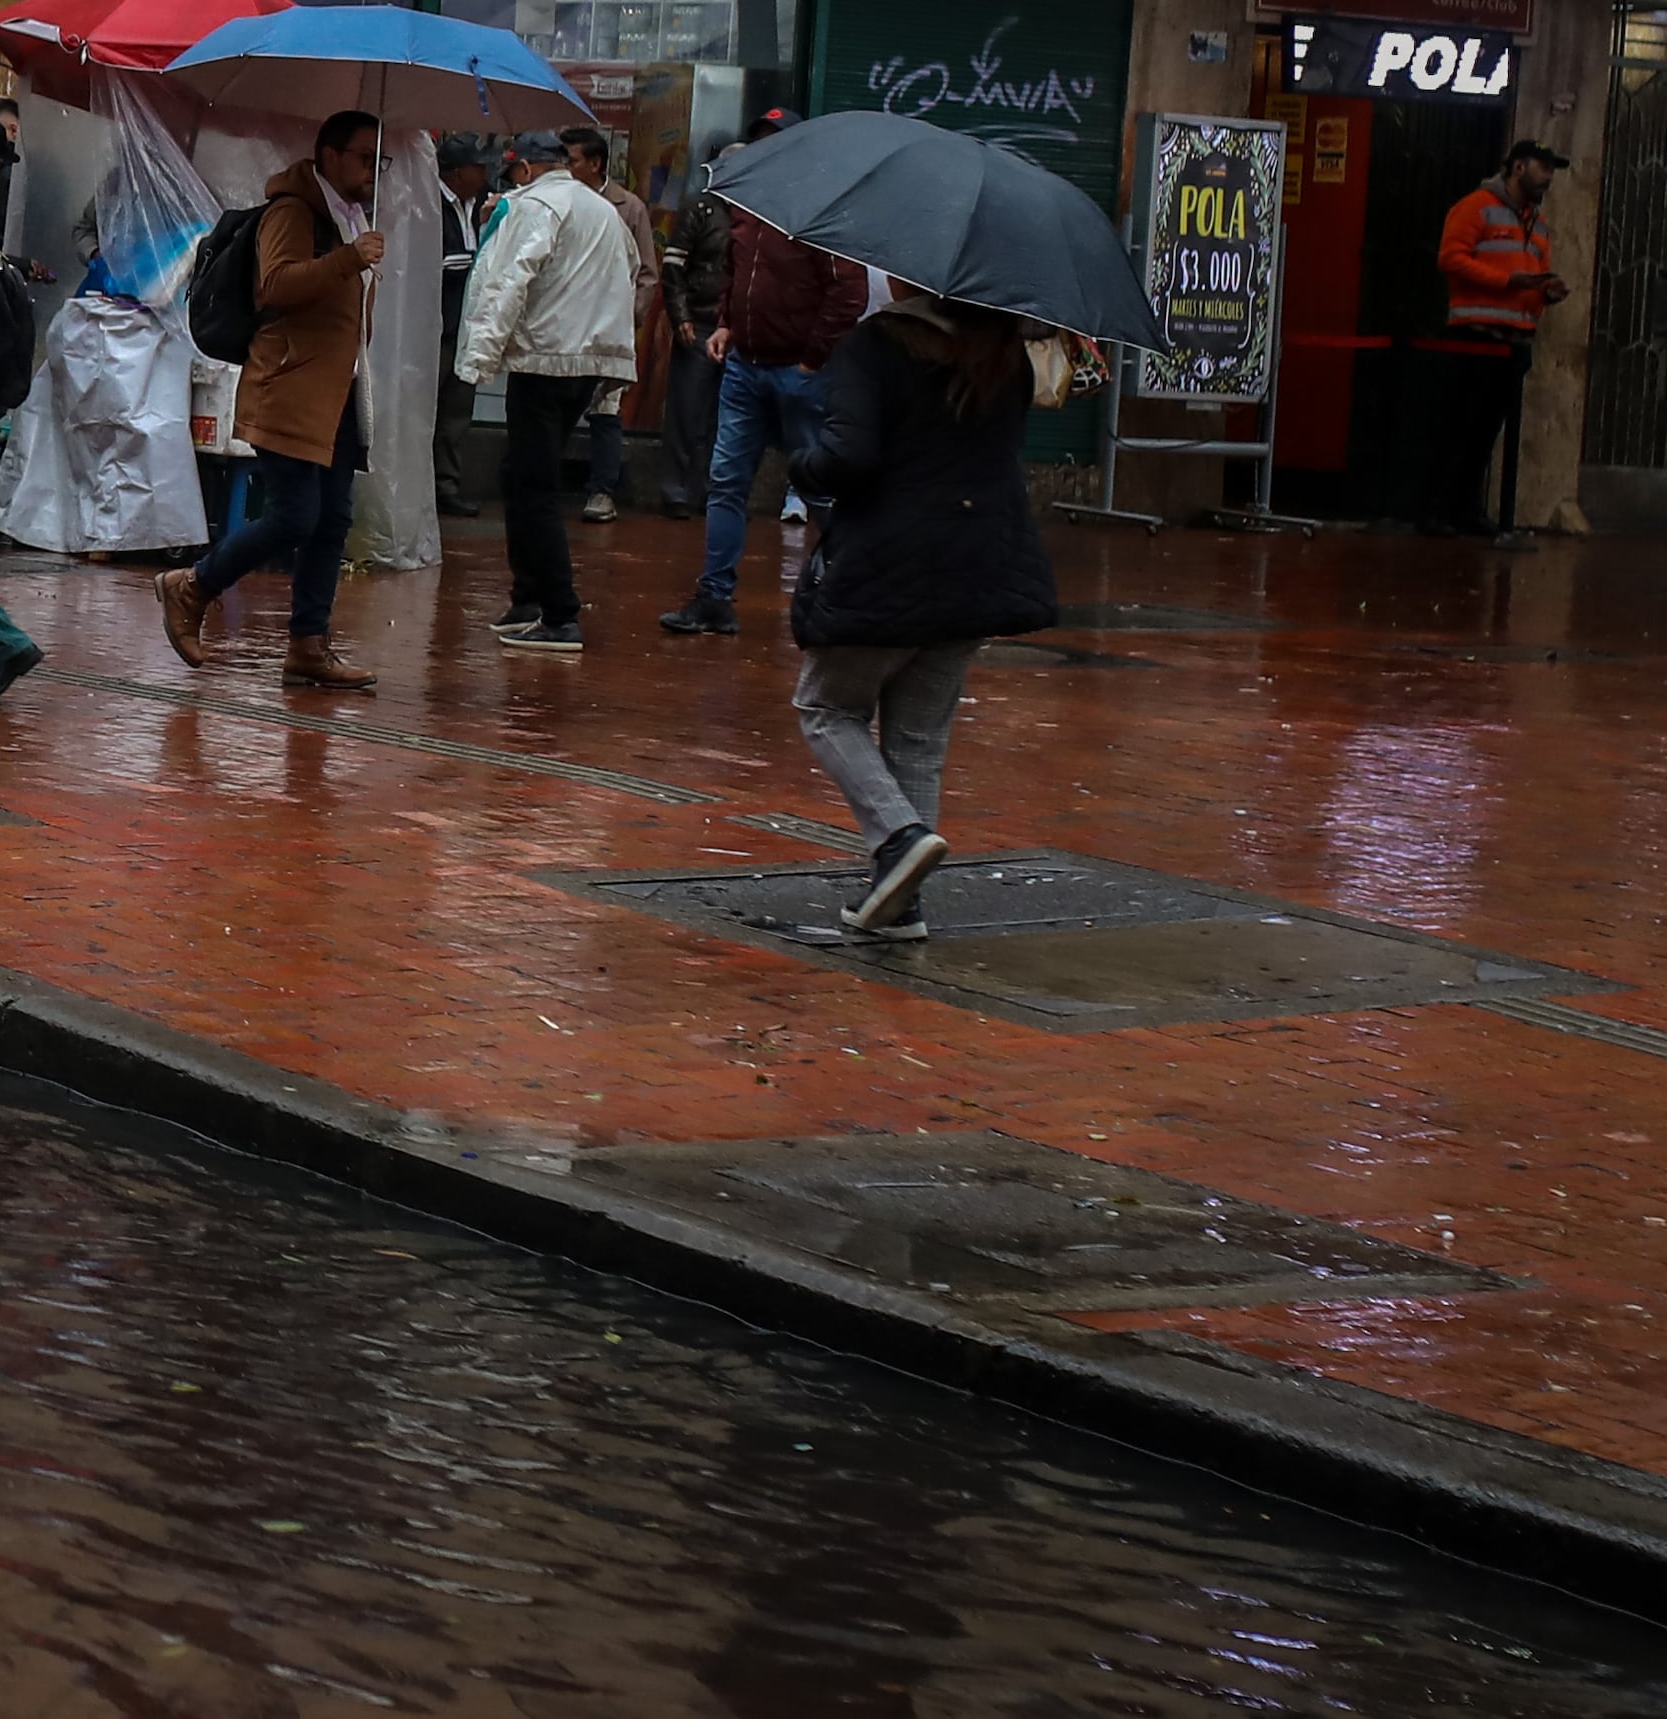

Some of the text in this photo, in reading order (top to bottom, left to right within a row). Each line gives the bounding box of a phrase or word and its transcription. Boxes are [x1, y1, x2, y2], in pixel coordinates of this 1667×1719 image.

[1179, 184, 1246, 242] POLA
[1180, 246, 1242, 294] $3.000
[1171, 297, 1197, 318] MARTES
[1204, 297, 1245, 321] MIÉRCOLES
